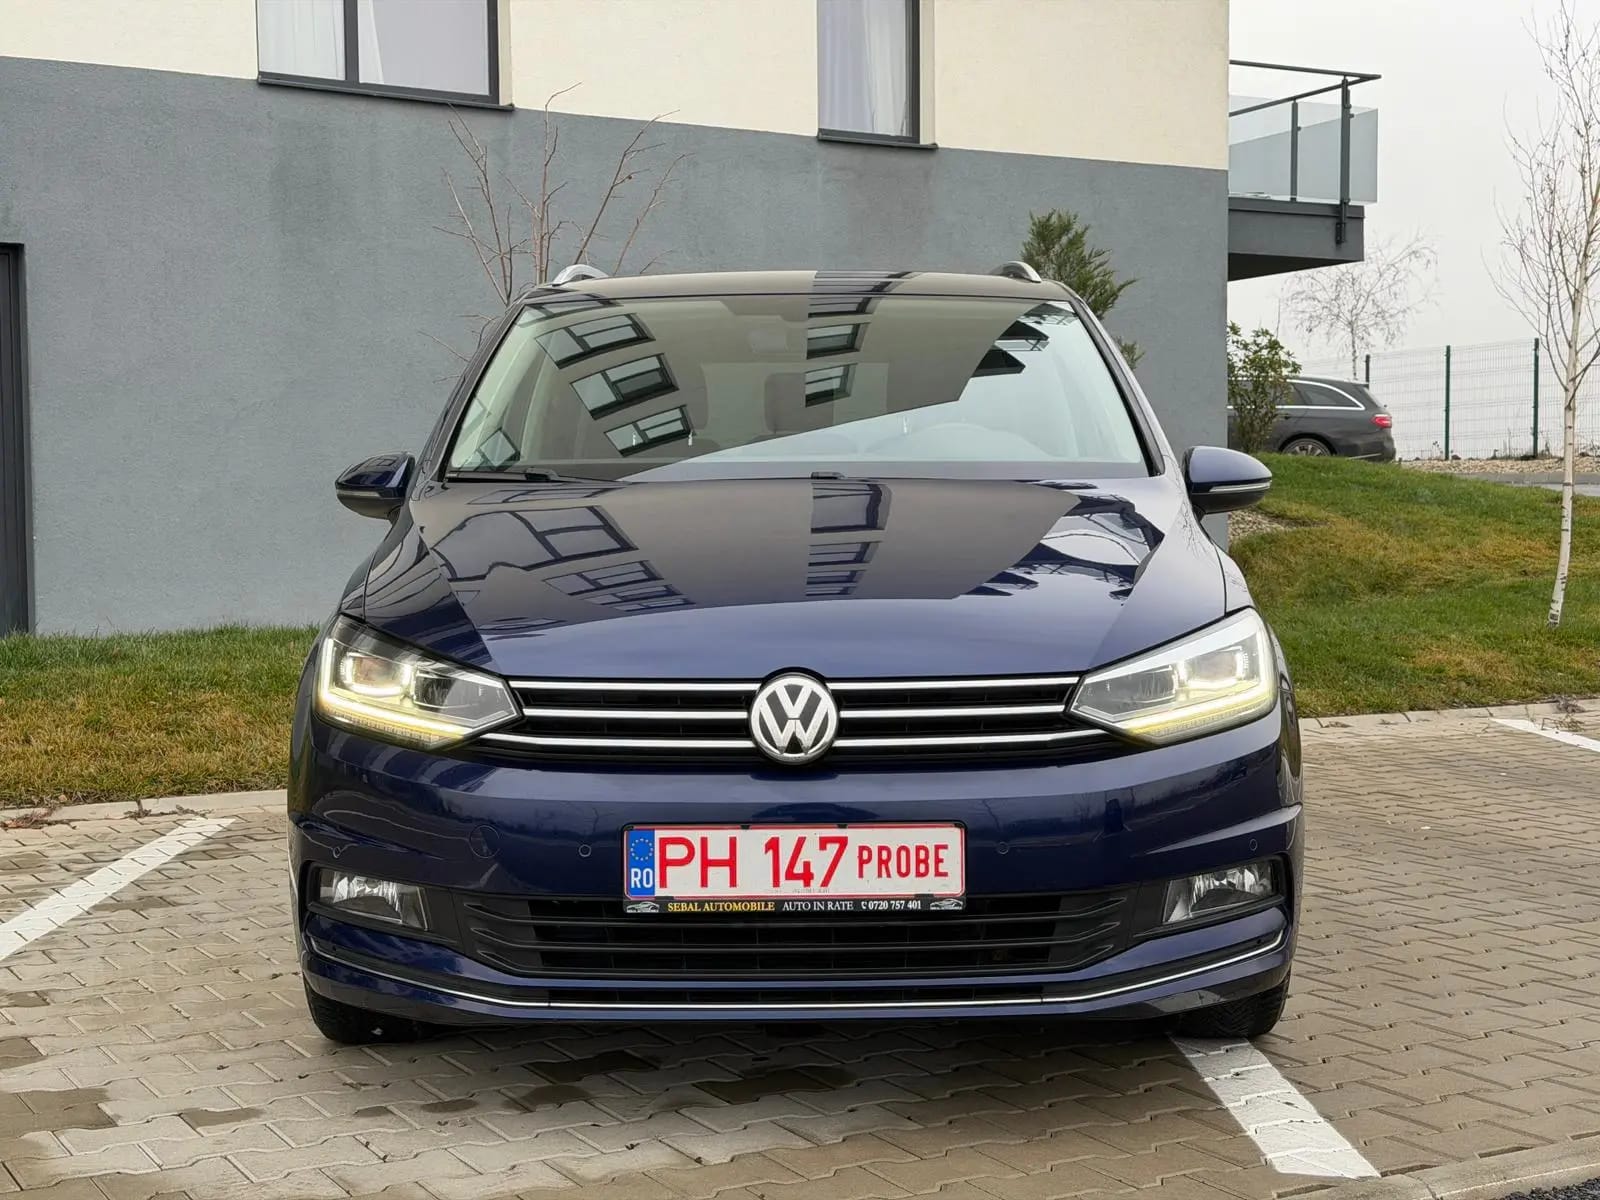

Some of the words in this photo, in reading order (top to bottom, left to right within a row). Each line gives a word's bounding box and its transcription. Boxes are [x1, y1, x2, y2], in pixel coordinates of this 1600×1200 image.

[757, 674, 830, 757] VW
[631, 868, 653, 888] RO
[659, 837, 737, 888] PH
[764, 837, 848, 888] 147
[857, 844, 949, 879] PROBE
[667, 902, 701, 912] SEBAL
[702, 901, 775, 912] AUTOMOBILE
[782, 902, 811, 911] AUTO
[813, 902, 826, 911] IN
[827, 902, 854, 911] RATE
[868, 901, 888, 910] 0720
[891, 901, 905, 910] 757
[907, 901, 921, 910] 401
